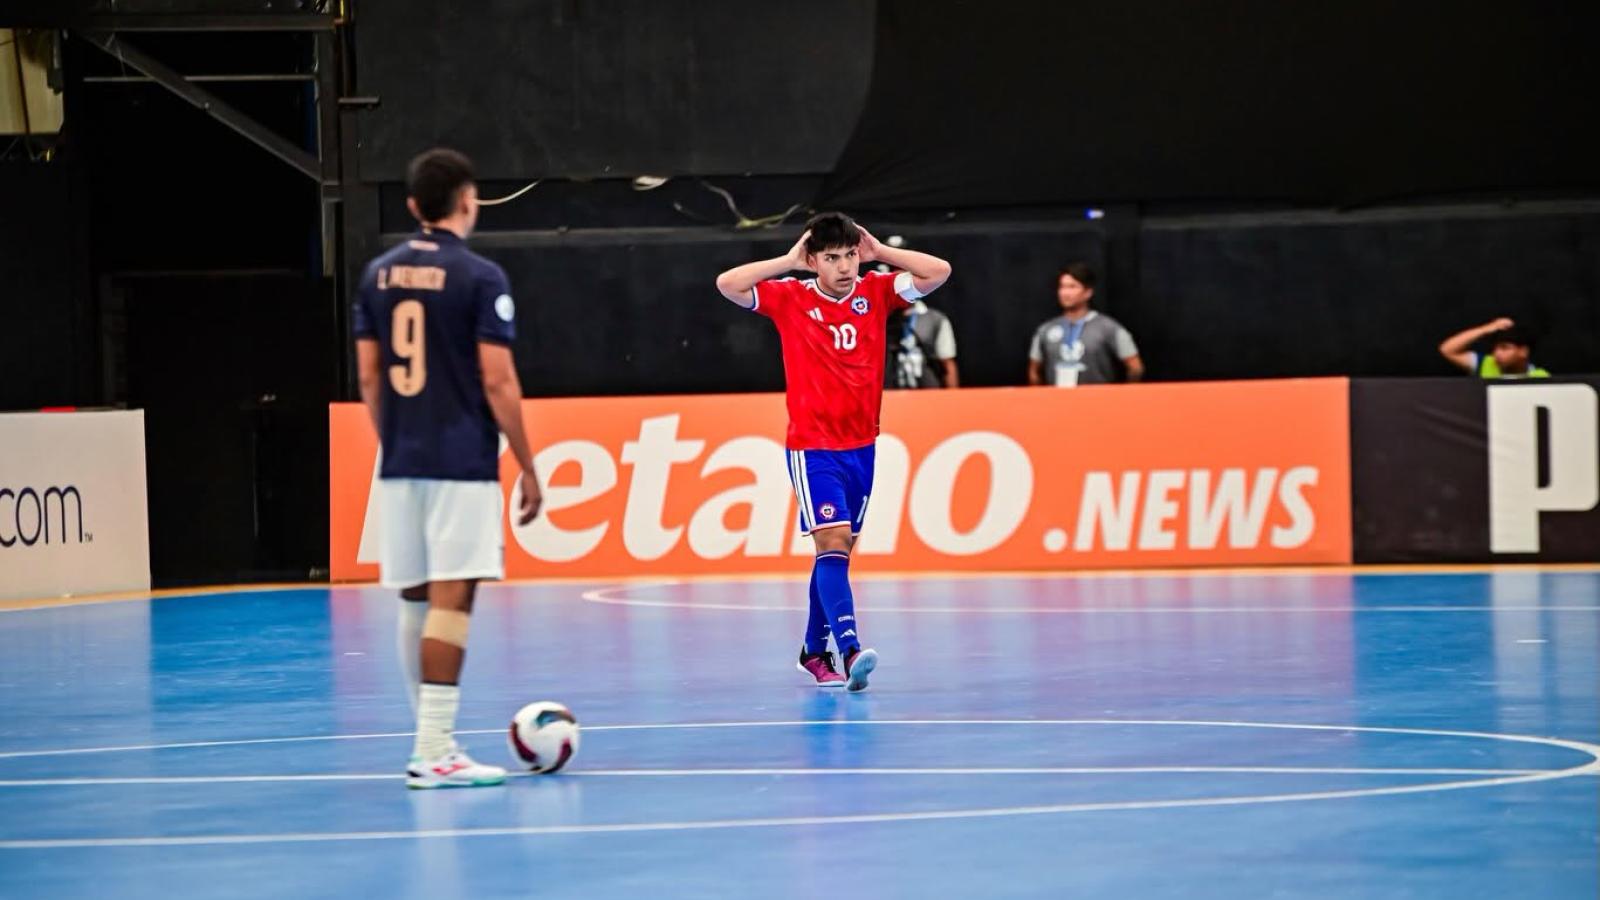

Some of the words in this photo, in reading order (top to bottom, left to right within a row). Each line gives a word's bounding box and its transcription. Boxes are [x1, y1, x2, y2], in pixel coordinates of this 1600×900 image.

[388, 299, 427, 397] 9
[828, 322, 857, 350] 10
[357, 413, 1033, 564] etano
[1487, 383, 1600, 553] P
